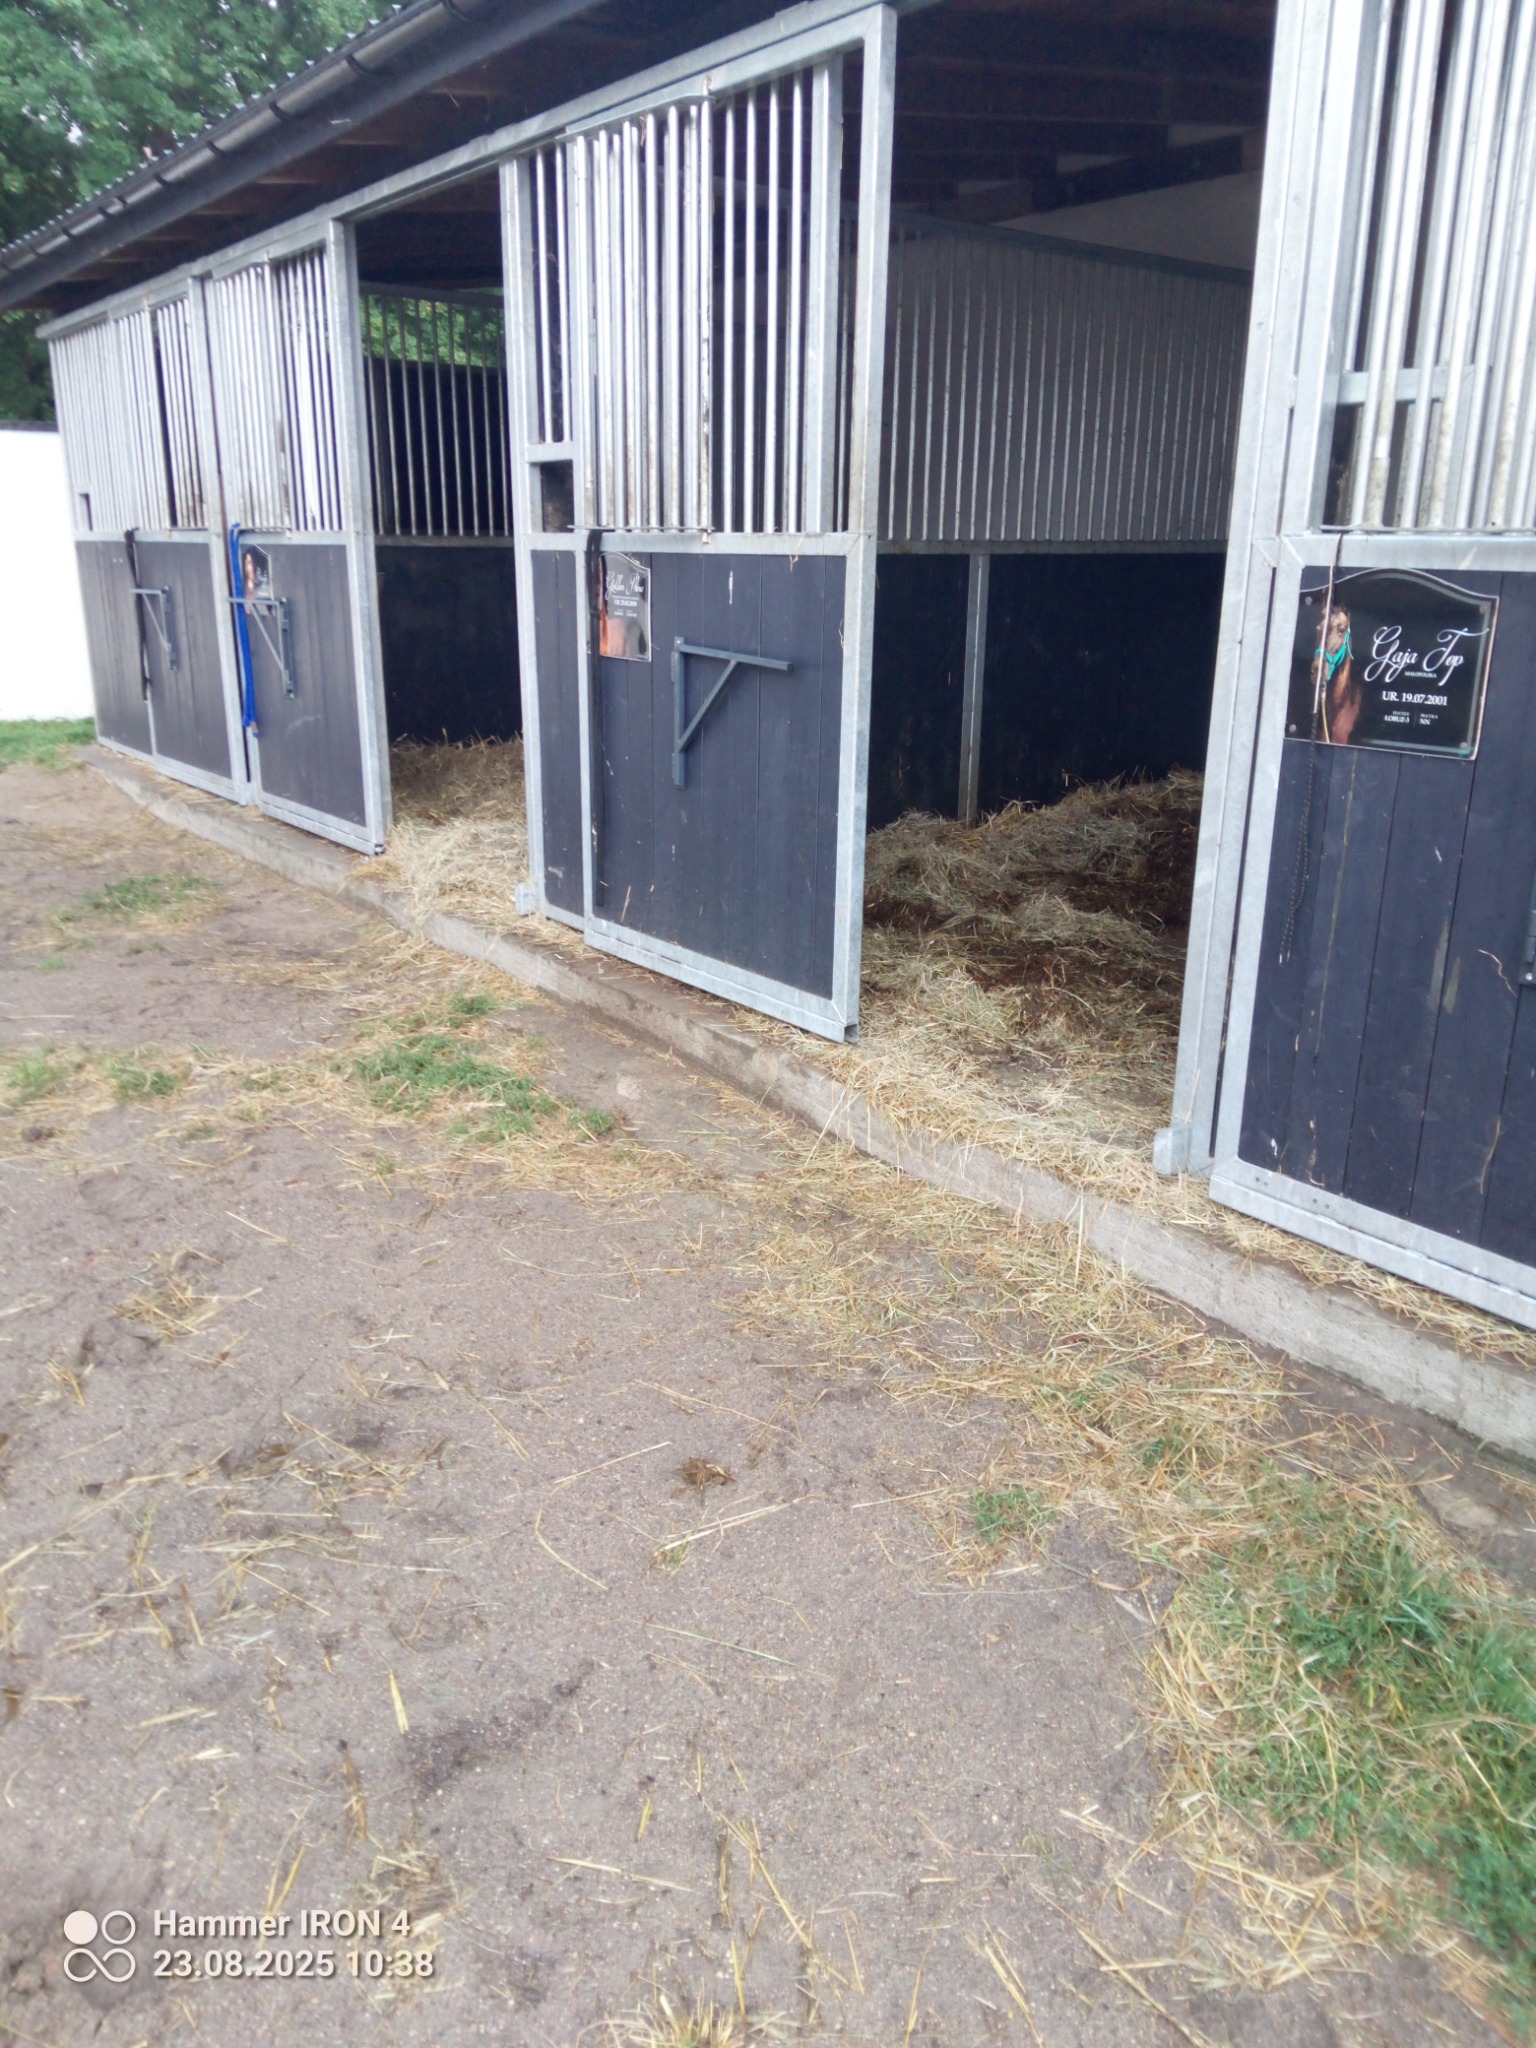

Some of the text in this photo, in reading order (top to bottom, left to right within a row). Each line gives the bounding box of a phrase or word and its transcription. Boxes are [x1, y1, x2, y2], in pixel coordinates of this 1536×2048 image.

[1364, 625, 1489, 686] Gaja Top
[1382, 690, 1448, 706] UR. 19.07.2001
